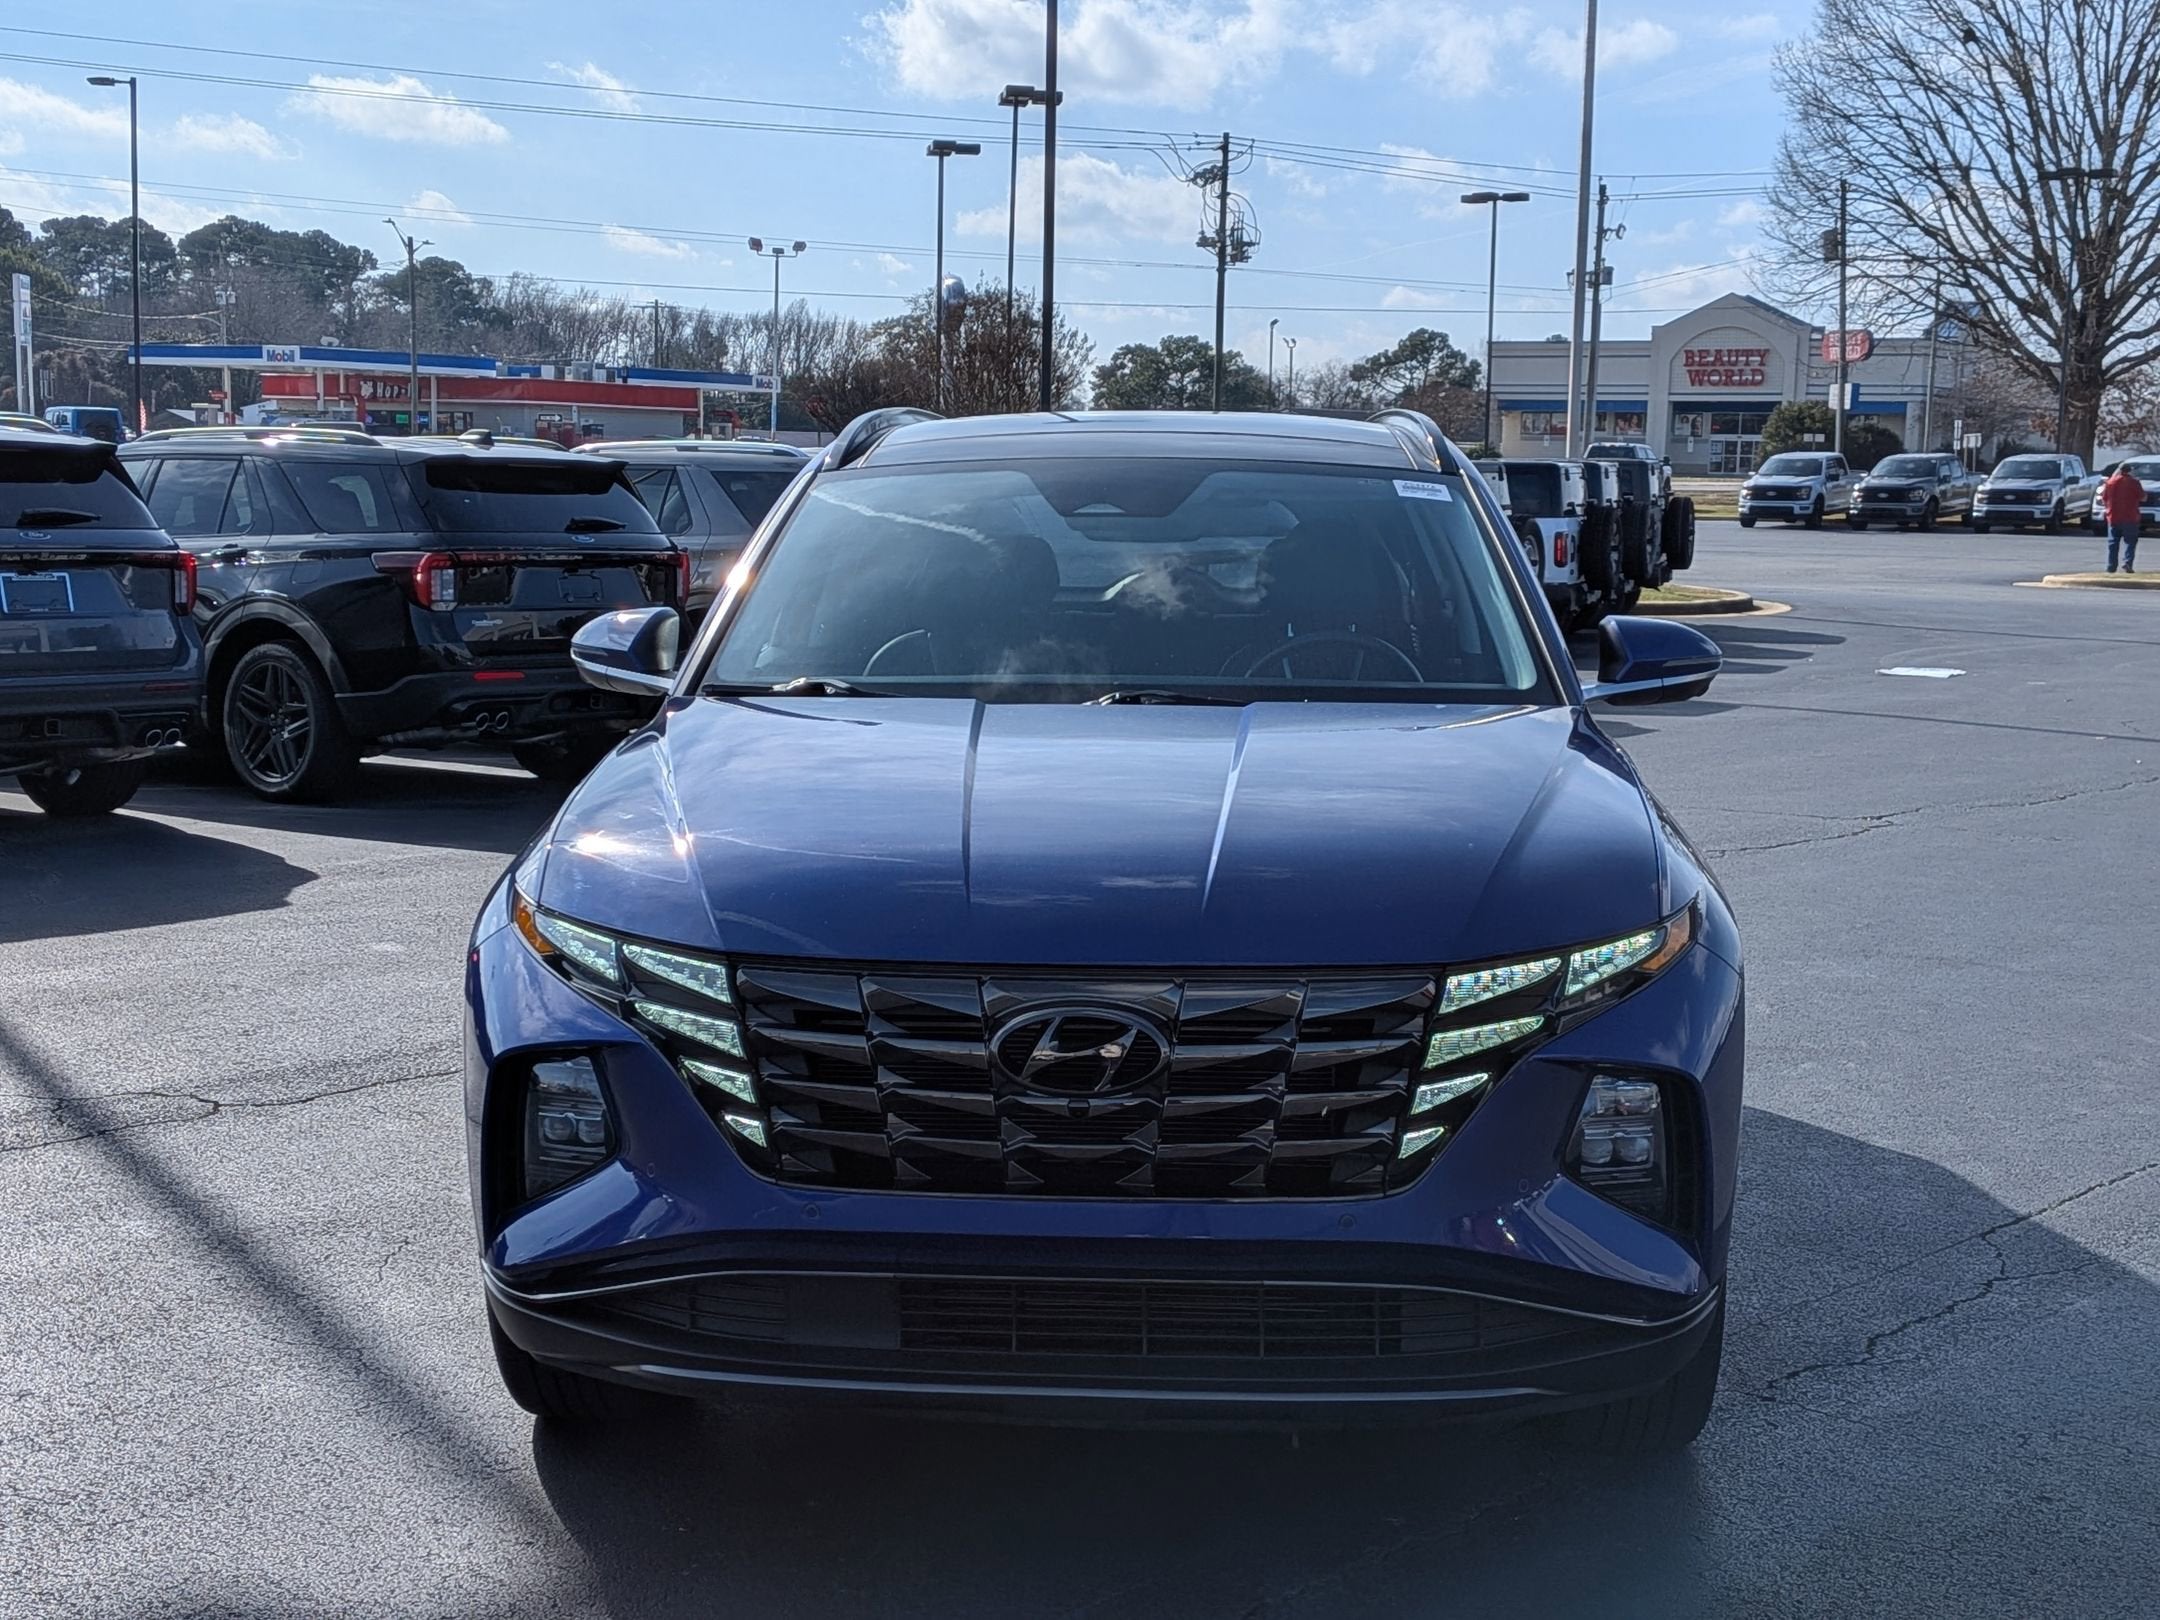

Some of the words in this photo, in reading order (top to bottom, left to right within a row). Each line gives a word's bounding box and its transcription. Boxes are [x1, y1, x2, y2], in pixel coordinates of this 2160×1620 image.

[266, 349, 295, 362] Mobil
[1683, 348, 1771, 367] BEAUTY
[756, 377, 778, 390] Mobl
[1686, 368, 1765, 387] WORLD
